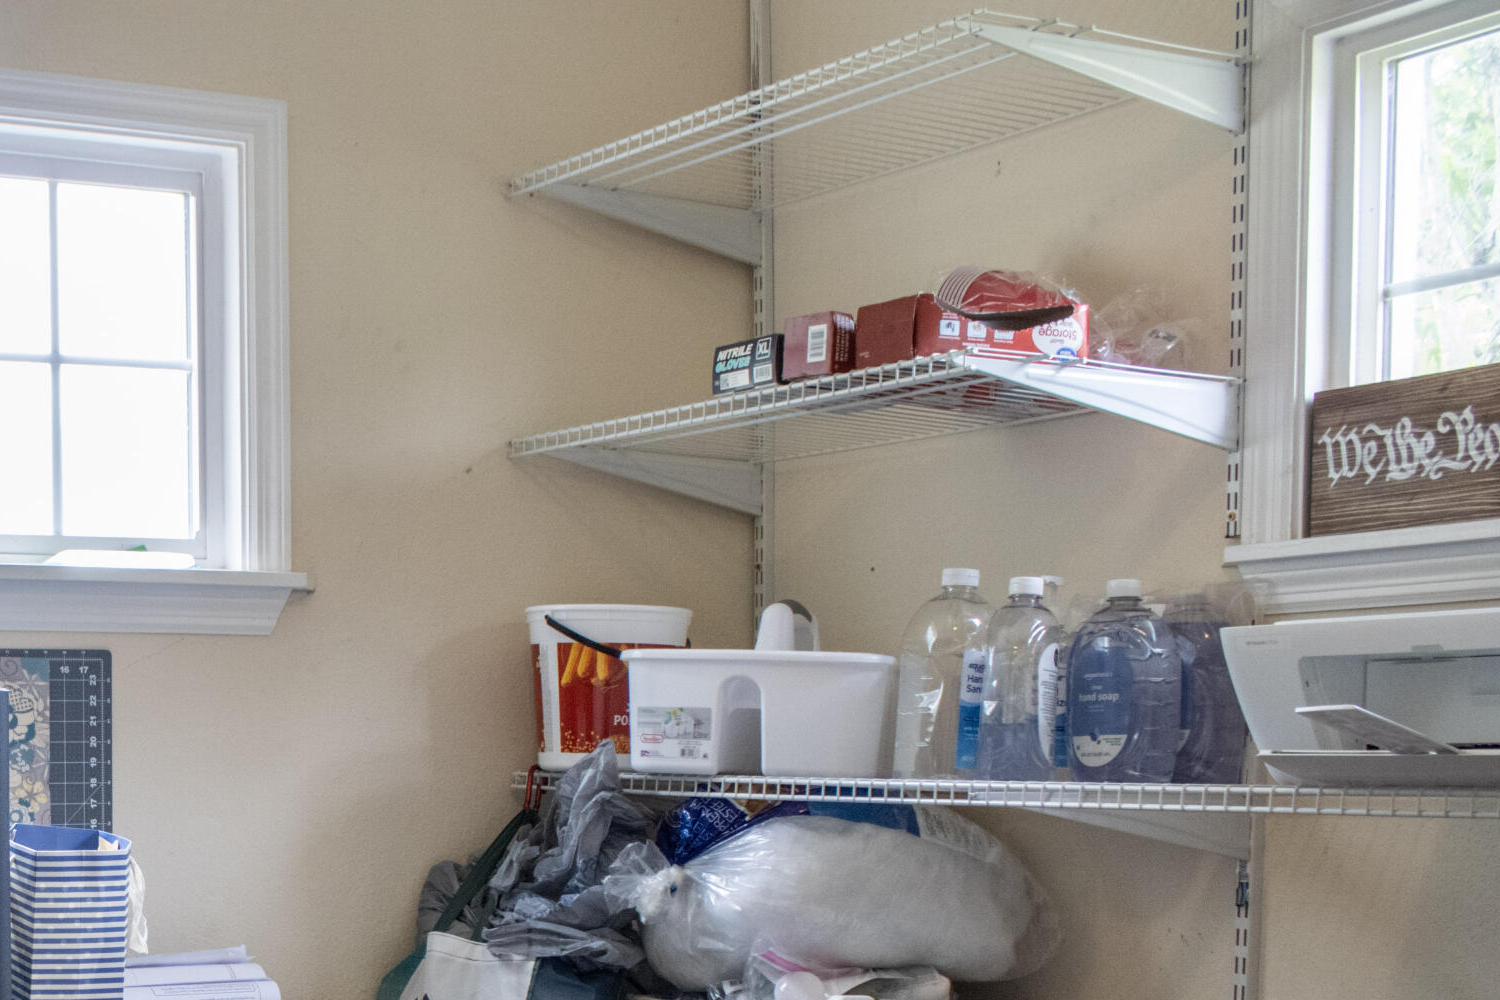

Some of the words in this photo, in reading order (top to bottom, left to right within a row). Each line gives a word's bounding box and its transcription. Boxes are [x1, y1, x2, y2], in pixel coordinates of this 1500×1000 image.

[1038, 326, 1077, 340] Storage
[716, 343, 754, 362] NITRILE
[758, 341, 769, 354] XL
[715, 355, 751, 374] GLOVES
[1318, 424, 1387, 488] We
[59, 665, 70, 674] 16
[78, 665, 89, 674] 17
[89, 674, 97, 686] 23
[89, 695, 97, 707] 22
[1098, 693, 1120, 703] soap
[89, 716, 97, 727] 21
[89, 736, 97, 748] 20
[90, 757, 98, 768] 19
[90, 778, 98, 788] 18
[90, 799, 98, 809] 17
